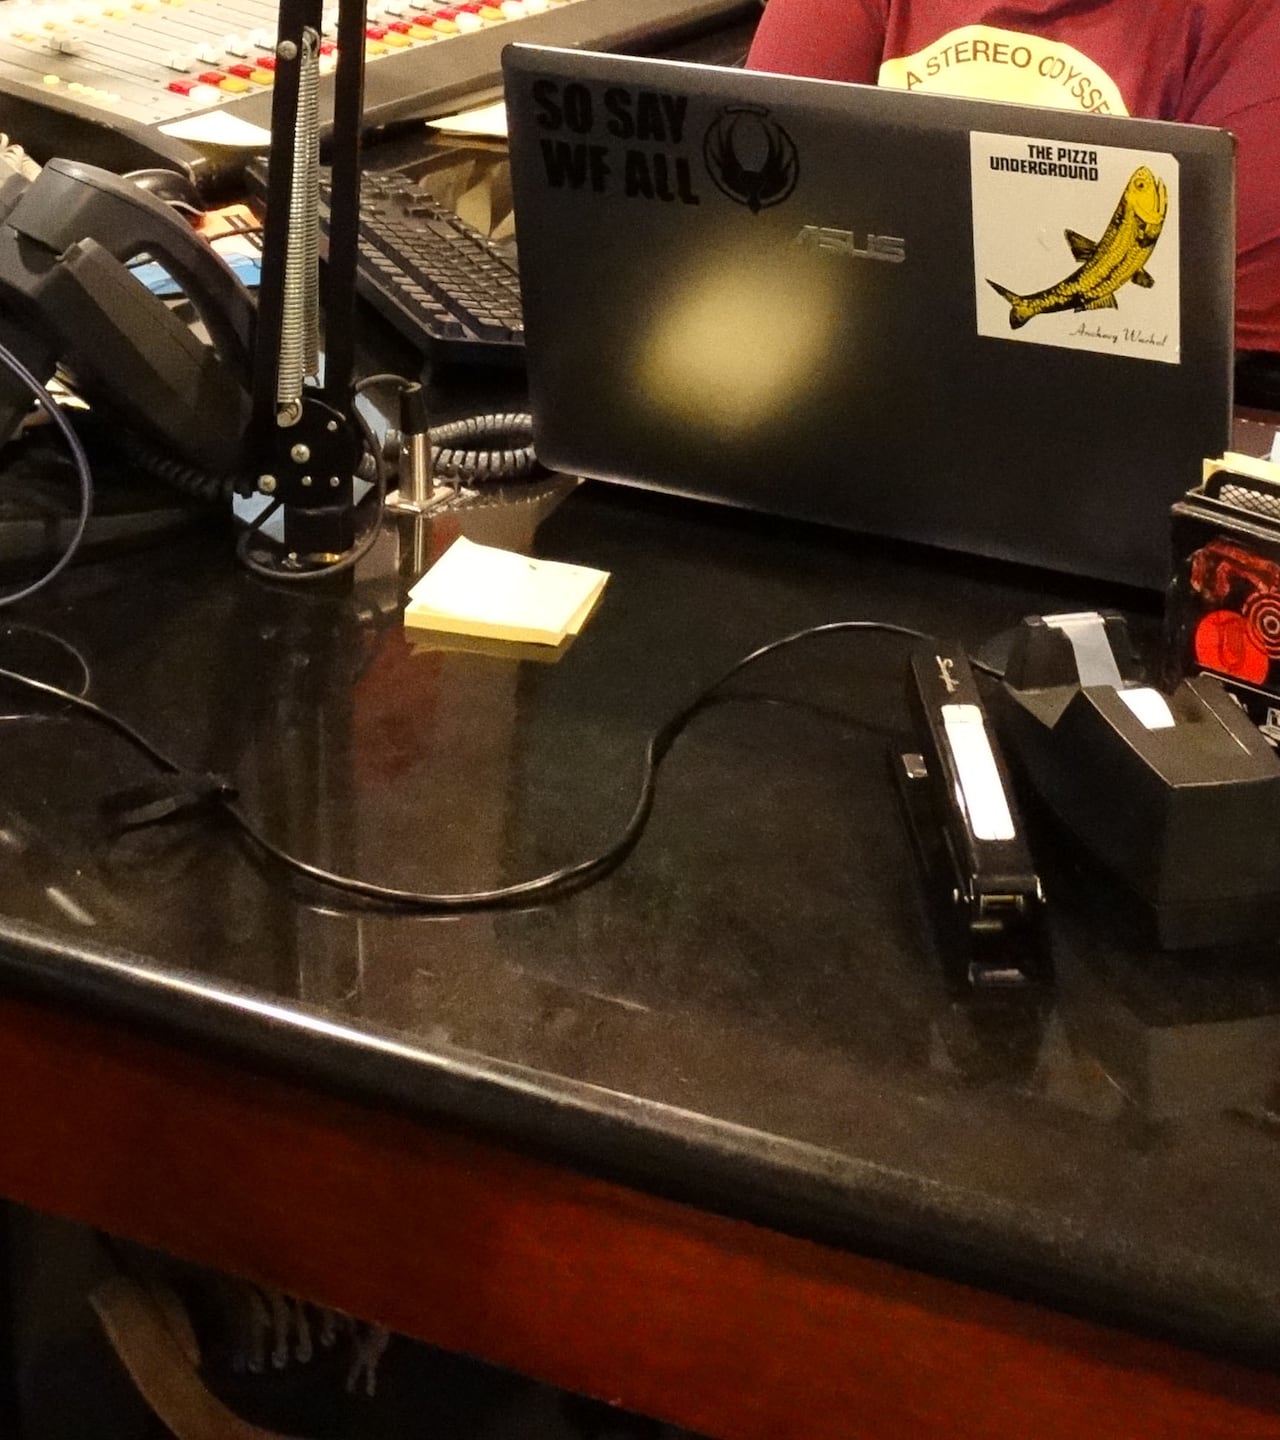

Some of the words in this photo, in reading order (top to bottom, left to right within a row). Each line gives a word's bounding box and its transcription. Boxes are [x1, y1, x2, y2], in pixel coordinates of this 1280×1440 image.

[905, 70, 924, 91] A
[926, 39, 1033, 77] STEREO
[1037, 54, 1113, 116] ODYSSE
[531, 78, 594, 134] SO
[603, 86, 689, 145] SAY
[624, 149, 701, 206] ALL
[989, 155, 1099, 182] UNDERGROUND
[1027, 144, 1054, 161] THE
[1057, 146, 1099, 165] PIZZA
[794, 224, 907, 264] ASUS
